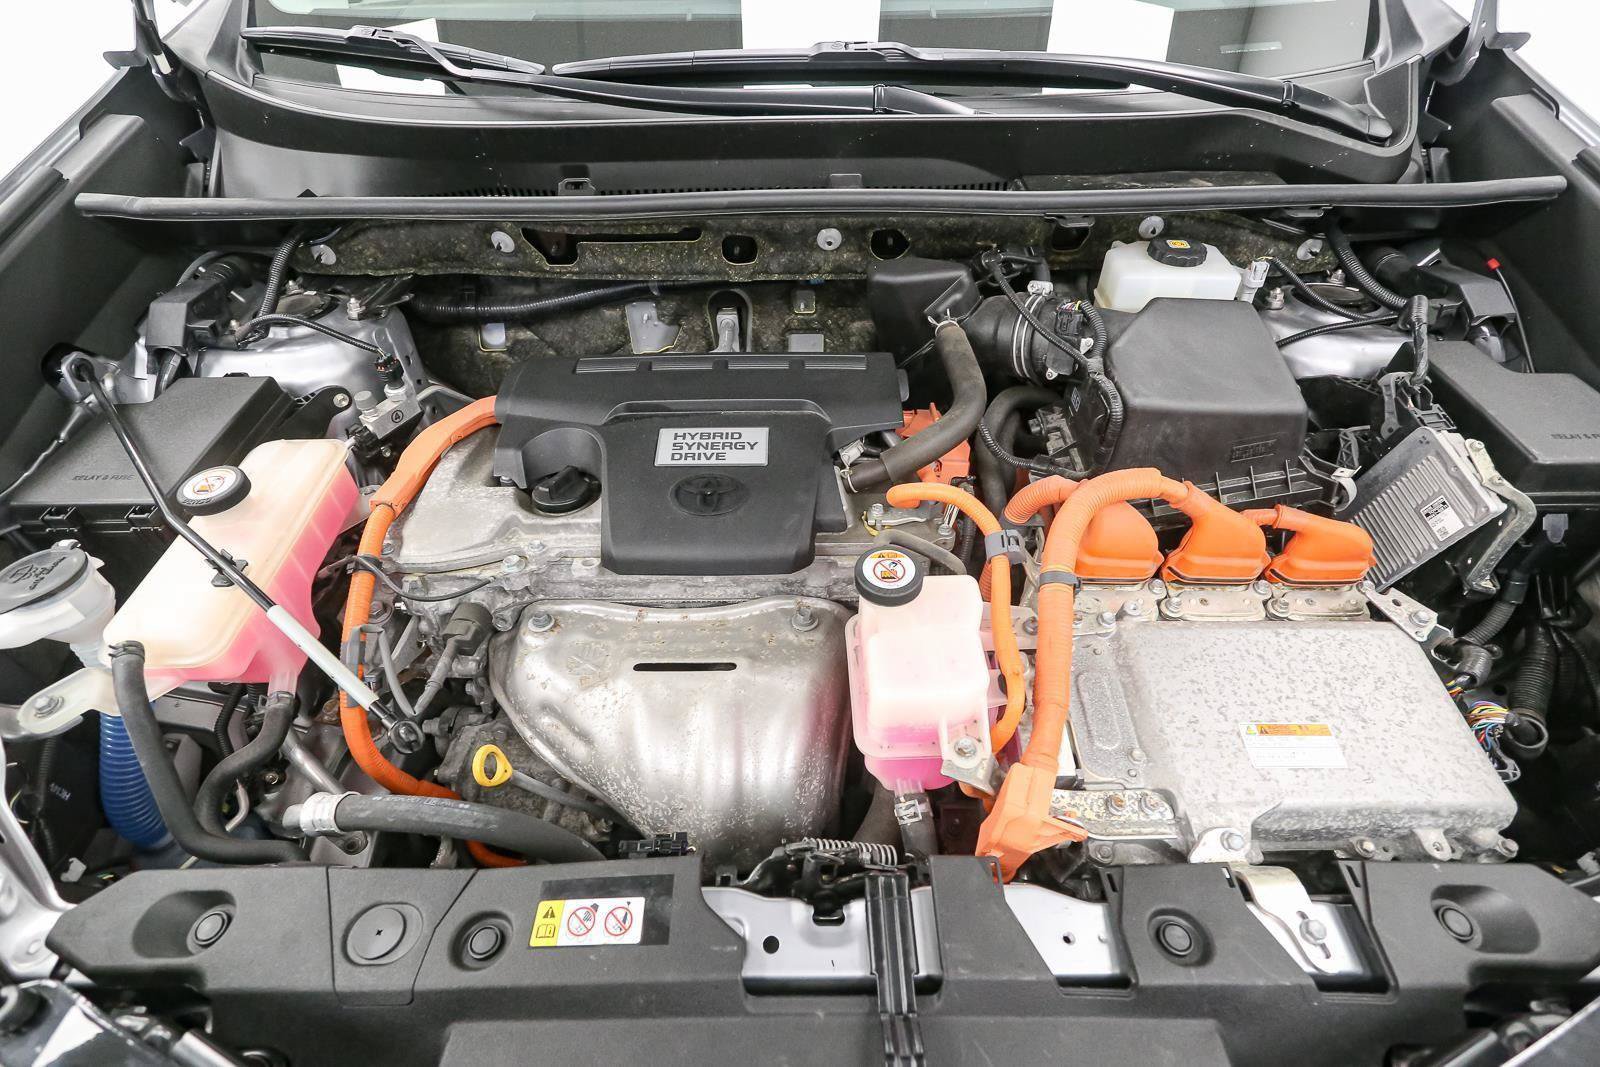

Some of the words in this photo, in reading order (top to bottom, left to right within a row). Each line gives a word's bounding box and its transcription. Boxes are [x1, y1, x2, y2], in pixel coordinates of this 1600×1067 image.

[673, 431, 743, 441] HYBRID
[671, 441, 759, 451] SYNERGY
[670, 452, 727, 461] DRIVE
